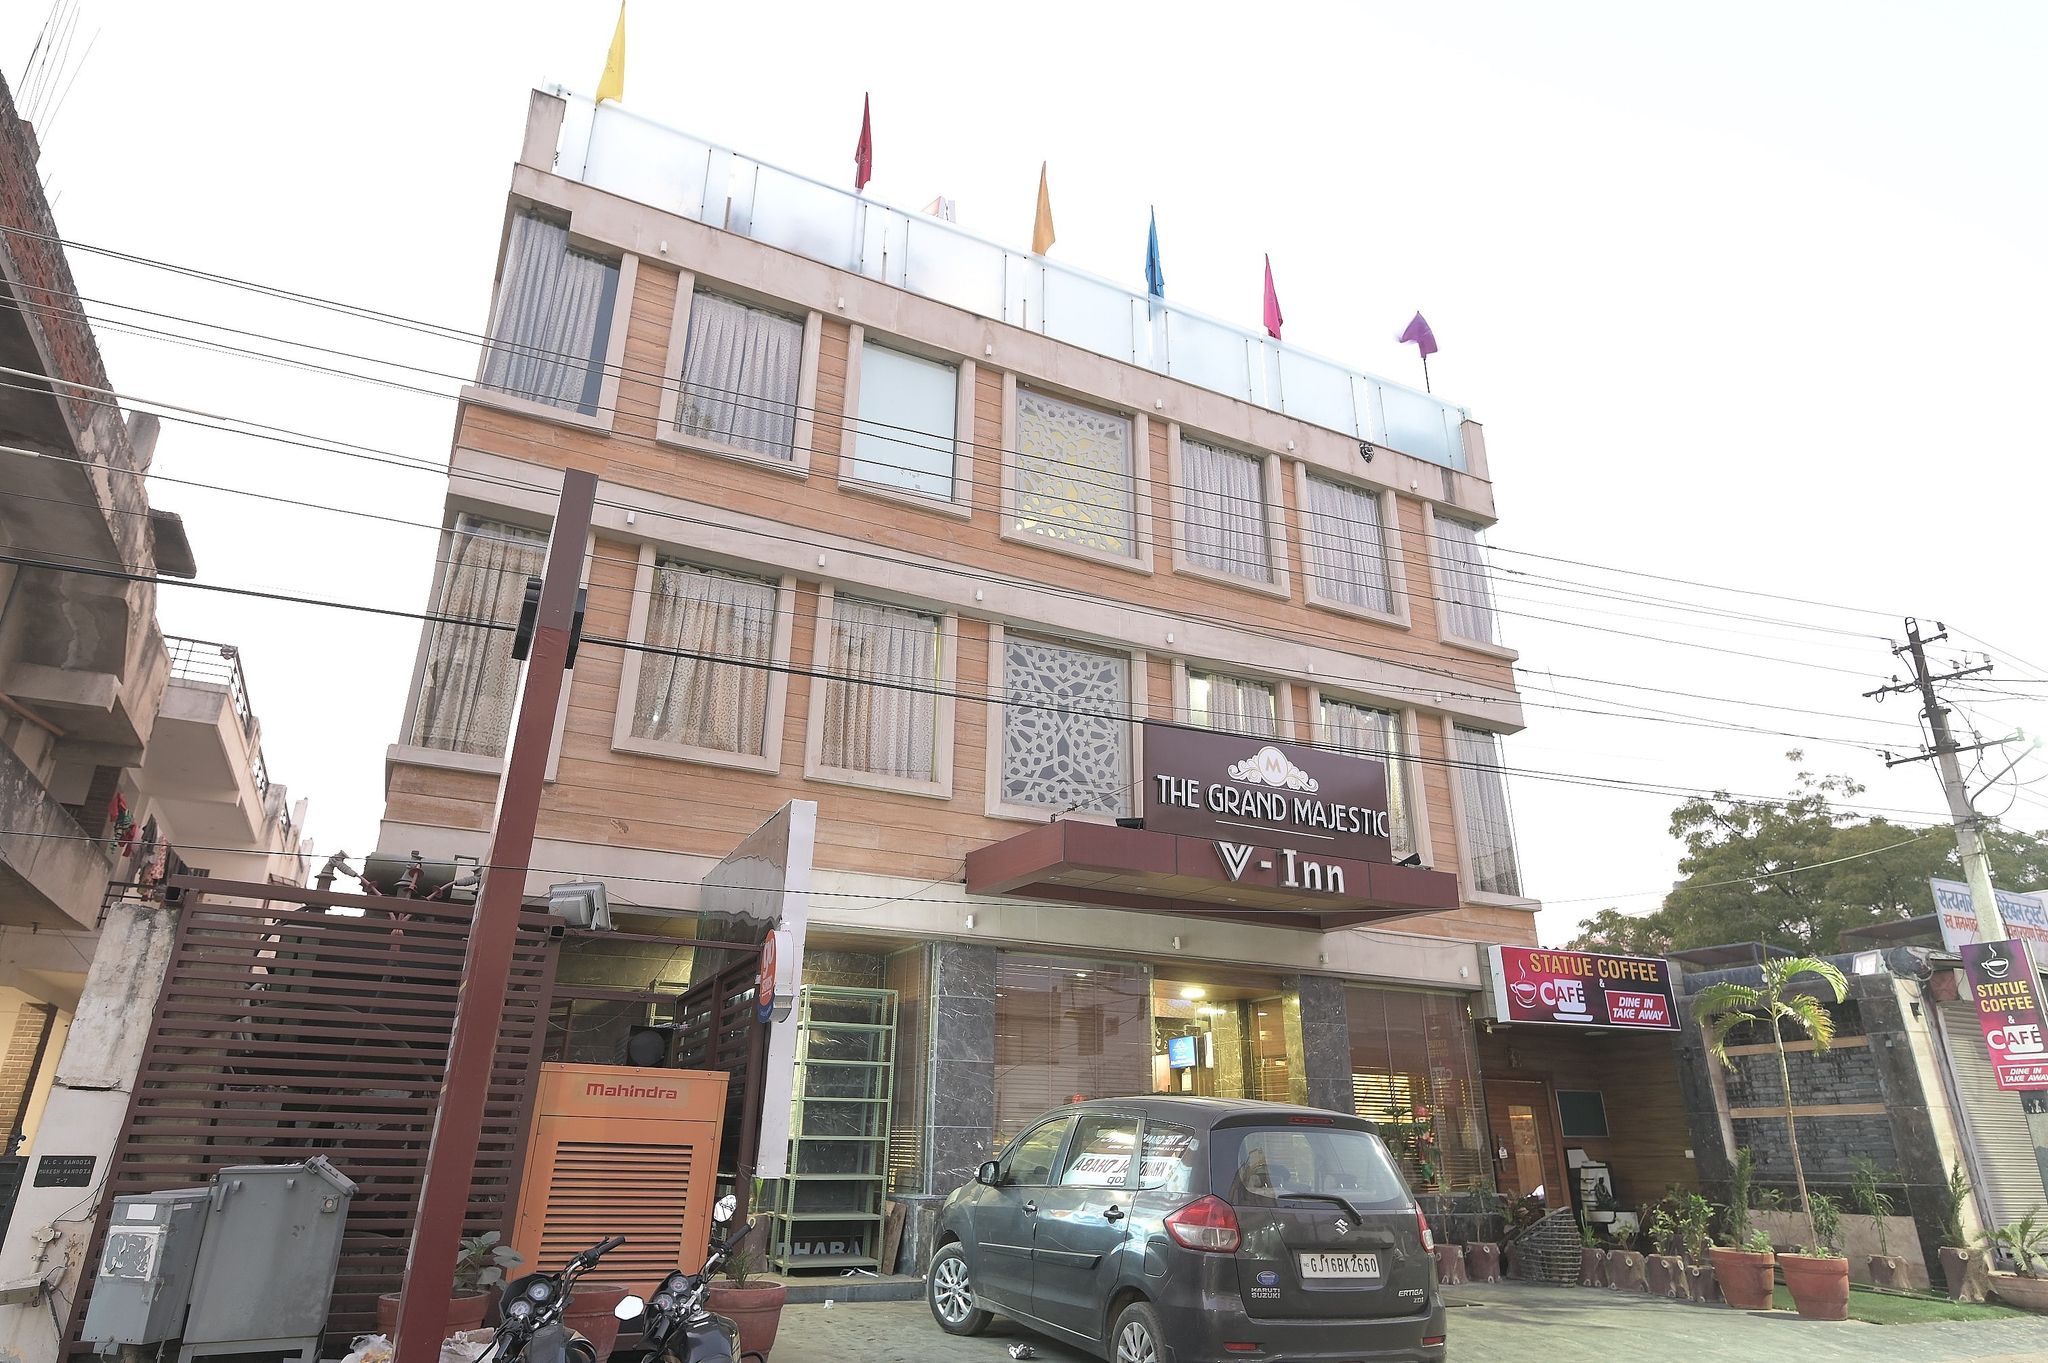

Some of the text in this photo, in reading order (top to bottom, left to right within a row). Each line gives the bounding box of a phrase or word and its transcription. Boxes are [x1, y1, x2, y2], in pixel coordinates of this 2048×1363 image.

[1264, 754, 1281, 773] M
[1156, 774, 1389, 838] THE GRAND MAJESTIC
[1530, 953, 1659, 982] STATUE COFFEE
[1599, 979, 1605, 988] &
[1976, 981, 2029, 998] STATUE
[1619, 996, 1654, 1008] DINE IN
[1980, 996, 2034, 1013] COFFEE
[1613, 1007, 1664, 1021] TAKE AWAY
[2008, 1016, 2015, 1024] &
[586, 1083, 678, 1099] Mahindra
[1310, 1257, 1377, 1272] GJ16BK2660
[1398, 1288, 1424, 1297] ERTIGA
